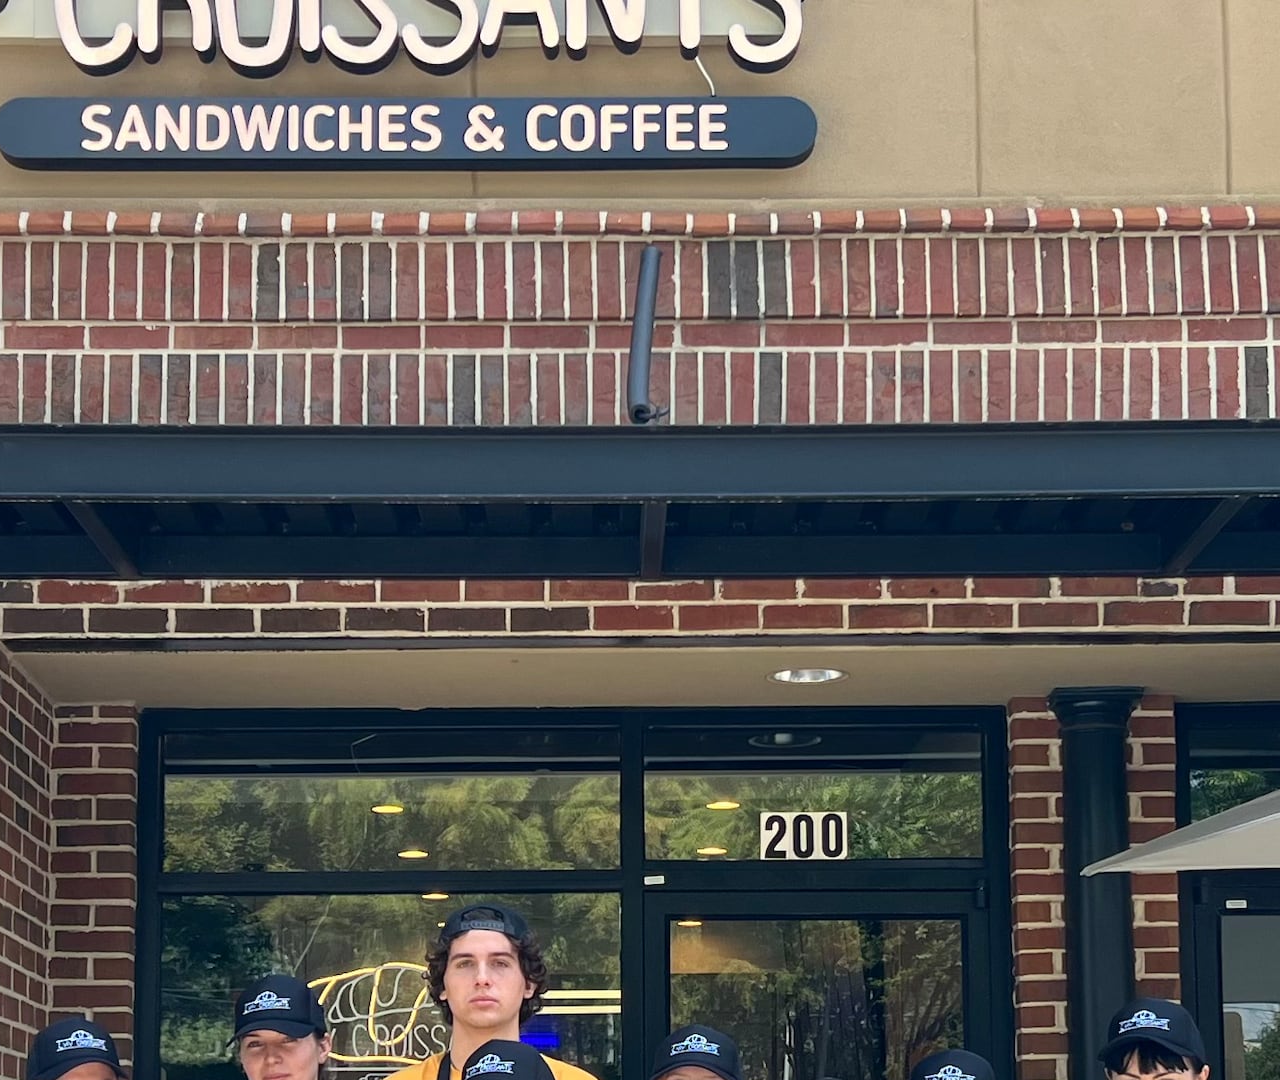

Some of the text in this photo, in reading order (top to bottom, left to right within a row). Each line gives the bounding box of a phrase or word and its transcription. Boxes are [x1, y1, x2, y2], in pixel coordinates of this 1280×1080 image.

[80, 104, 729, 152] SANDWICHES & COFFEE
[765, 813, 843, 859] 200
[352, 1023, 447, 1059] CROISS
